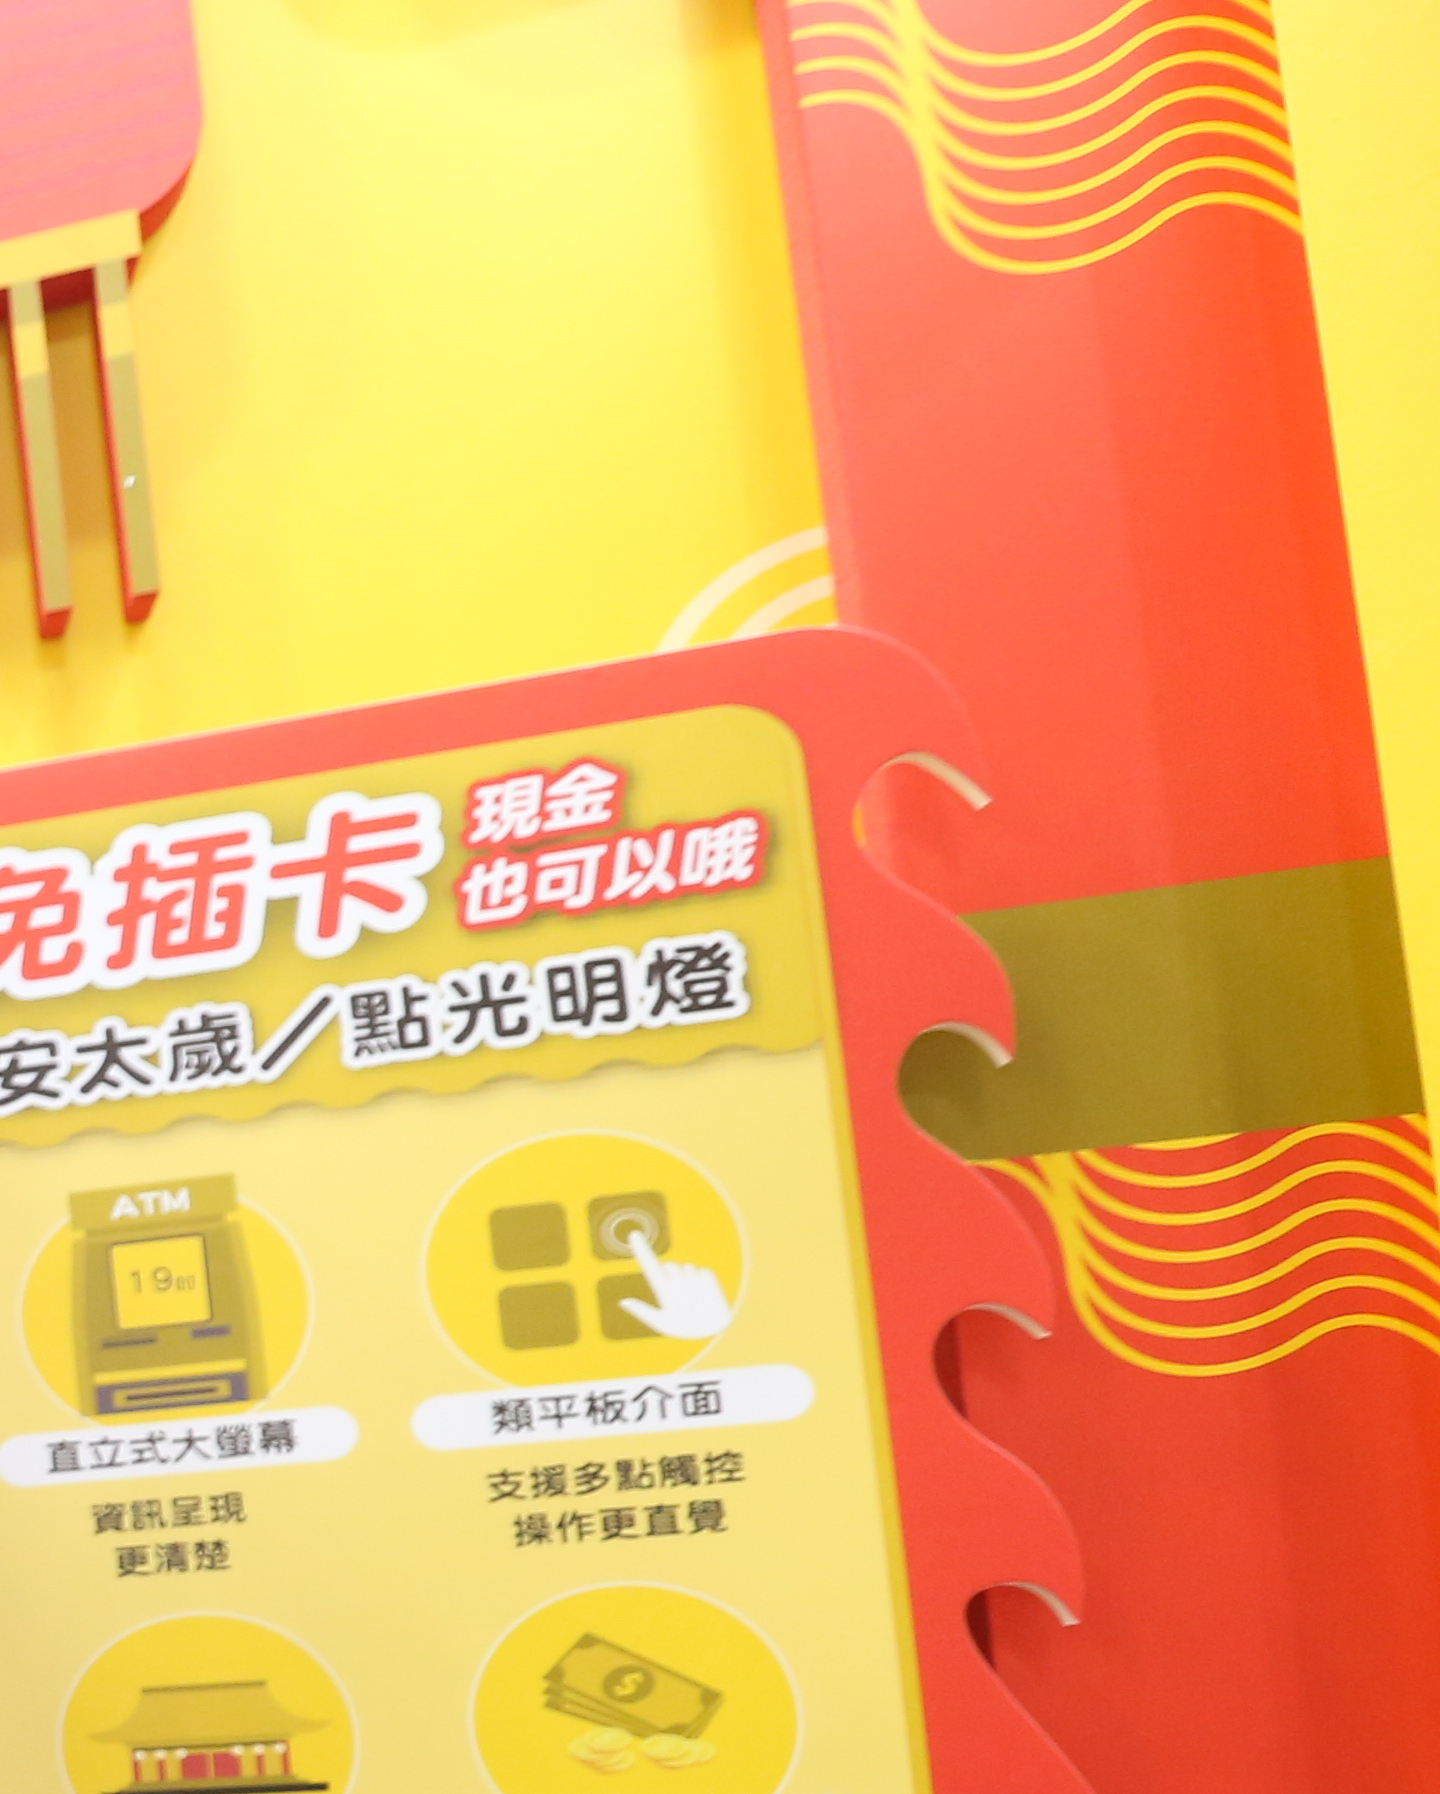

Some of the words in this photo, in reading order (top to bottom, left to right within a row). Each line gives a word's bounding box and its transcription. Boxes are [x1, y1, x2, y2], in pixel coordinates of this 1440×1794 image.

[470, 764, 618, 845] 現金
[458, 820, 760, 921] 也可以哦
[110, 1188, 191, 1219] ATM
[491, 1380, 723, 1433] 類平板介面
[46, 1419, 297, 1474] 直立式大螢幕
[486, 1452, 746, 1501] 支援多點觸控
[92, 1492, 246, 1534] 資訊呈現
[514, 1500, 727, 1547] 操作更直覺
[115, 1540, 232, 1578] 更清楚
